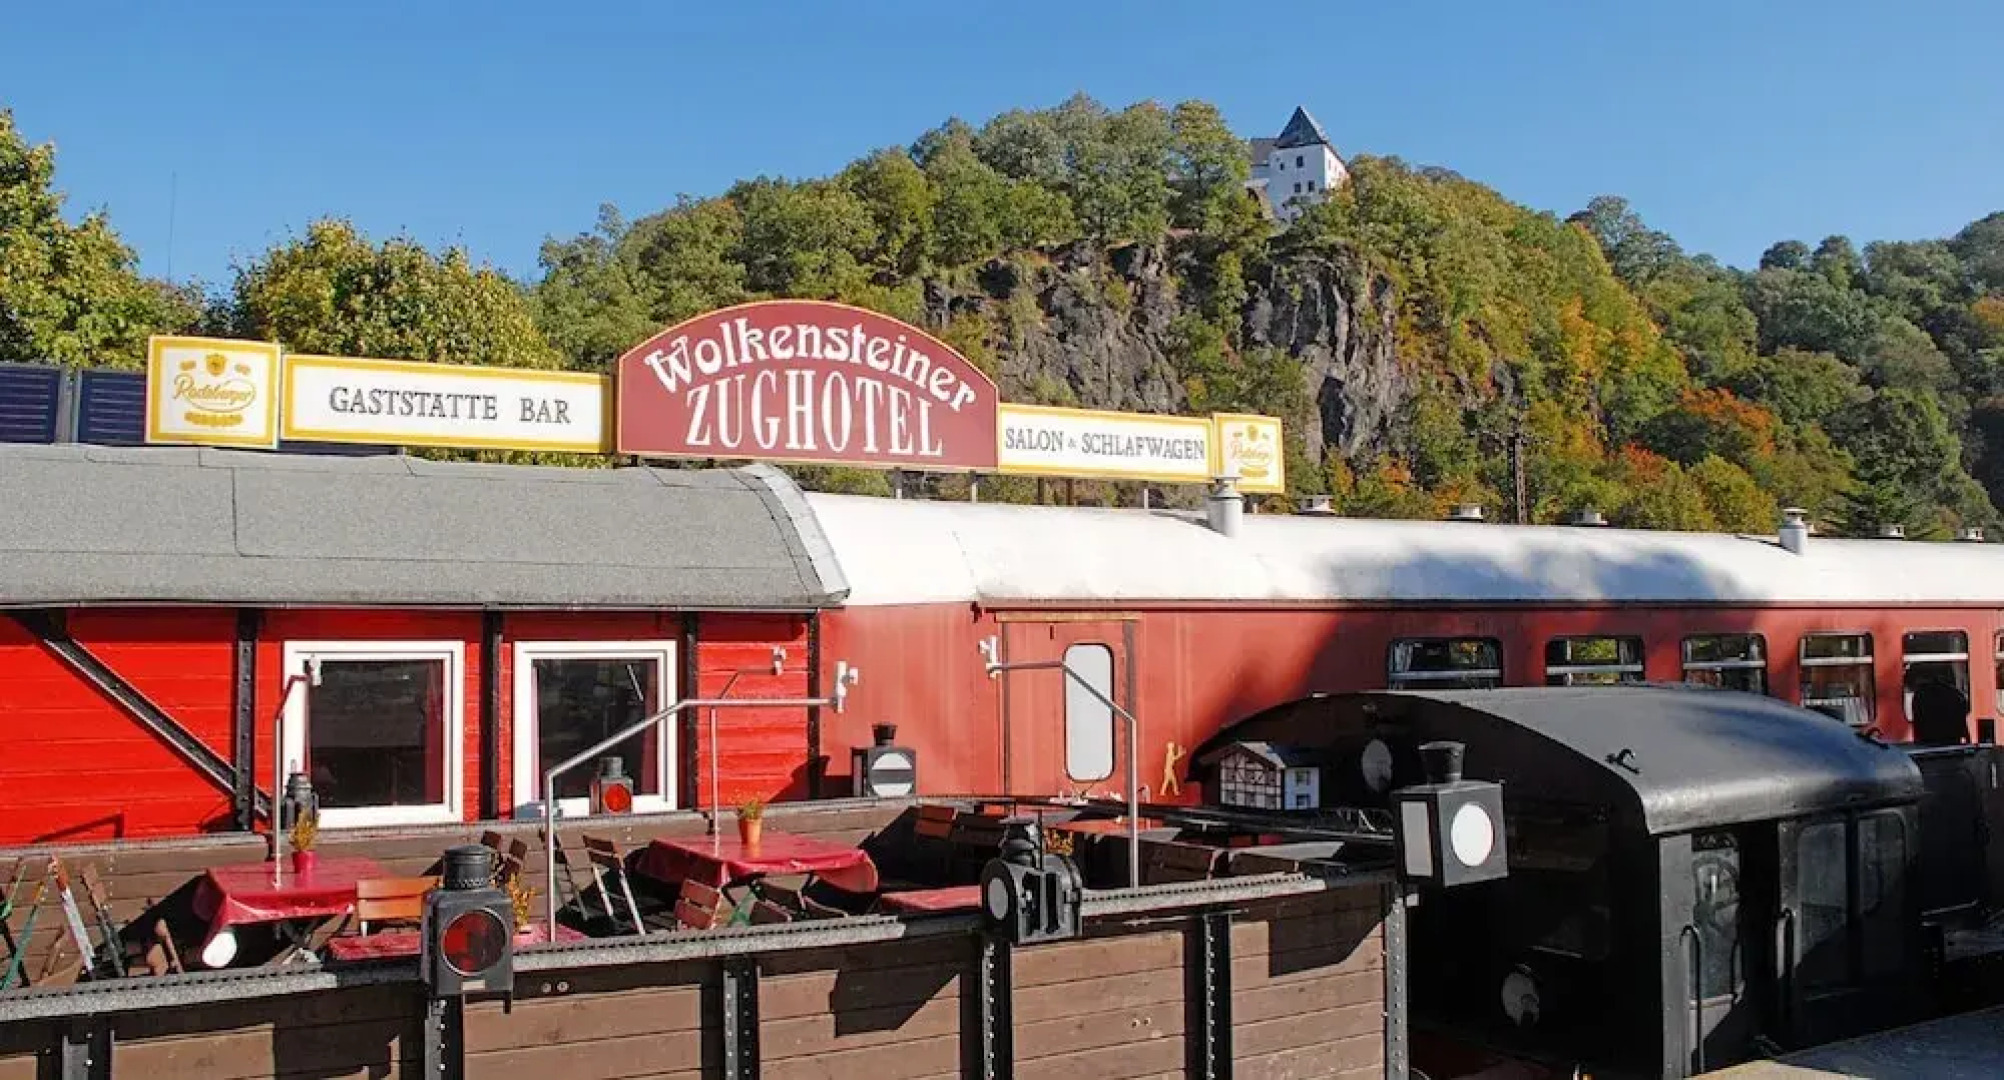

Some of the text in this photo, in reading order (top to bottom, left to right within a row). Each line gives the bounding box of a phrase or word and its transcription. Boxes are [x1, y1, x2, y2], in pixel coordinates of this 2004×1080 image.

[644, 318, 976, 411] Wolkensteiner
[519, 397, 571, 424] BAR
[686, 369, 943, 456] ZUGHOTEL
[1004, 428, 1064, 452] SALON
[1081, 433, 1205, 460] SCHLAFWAGEN
